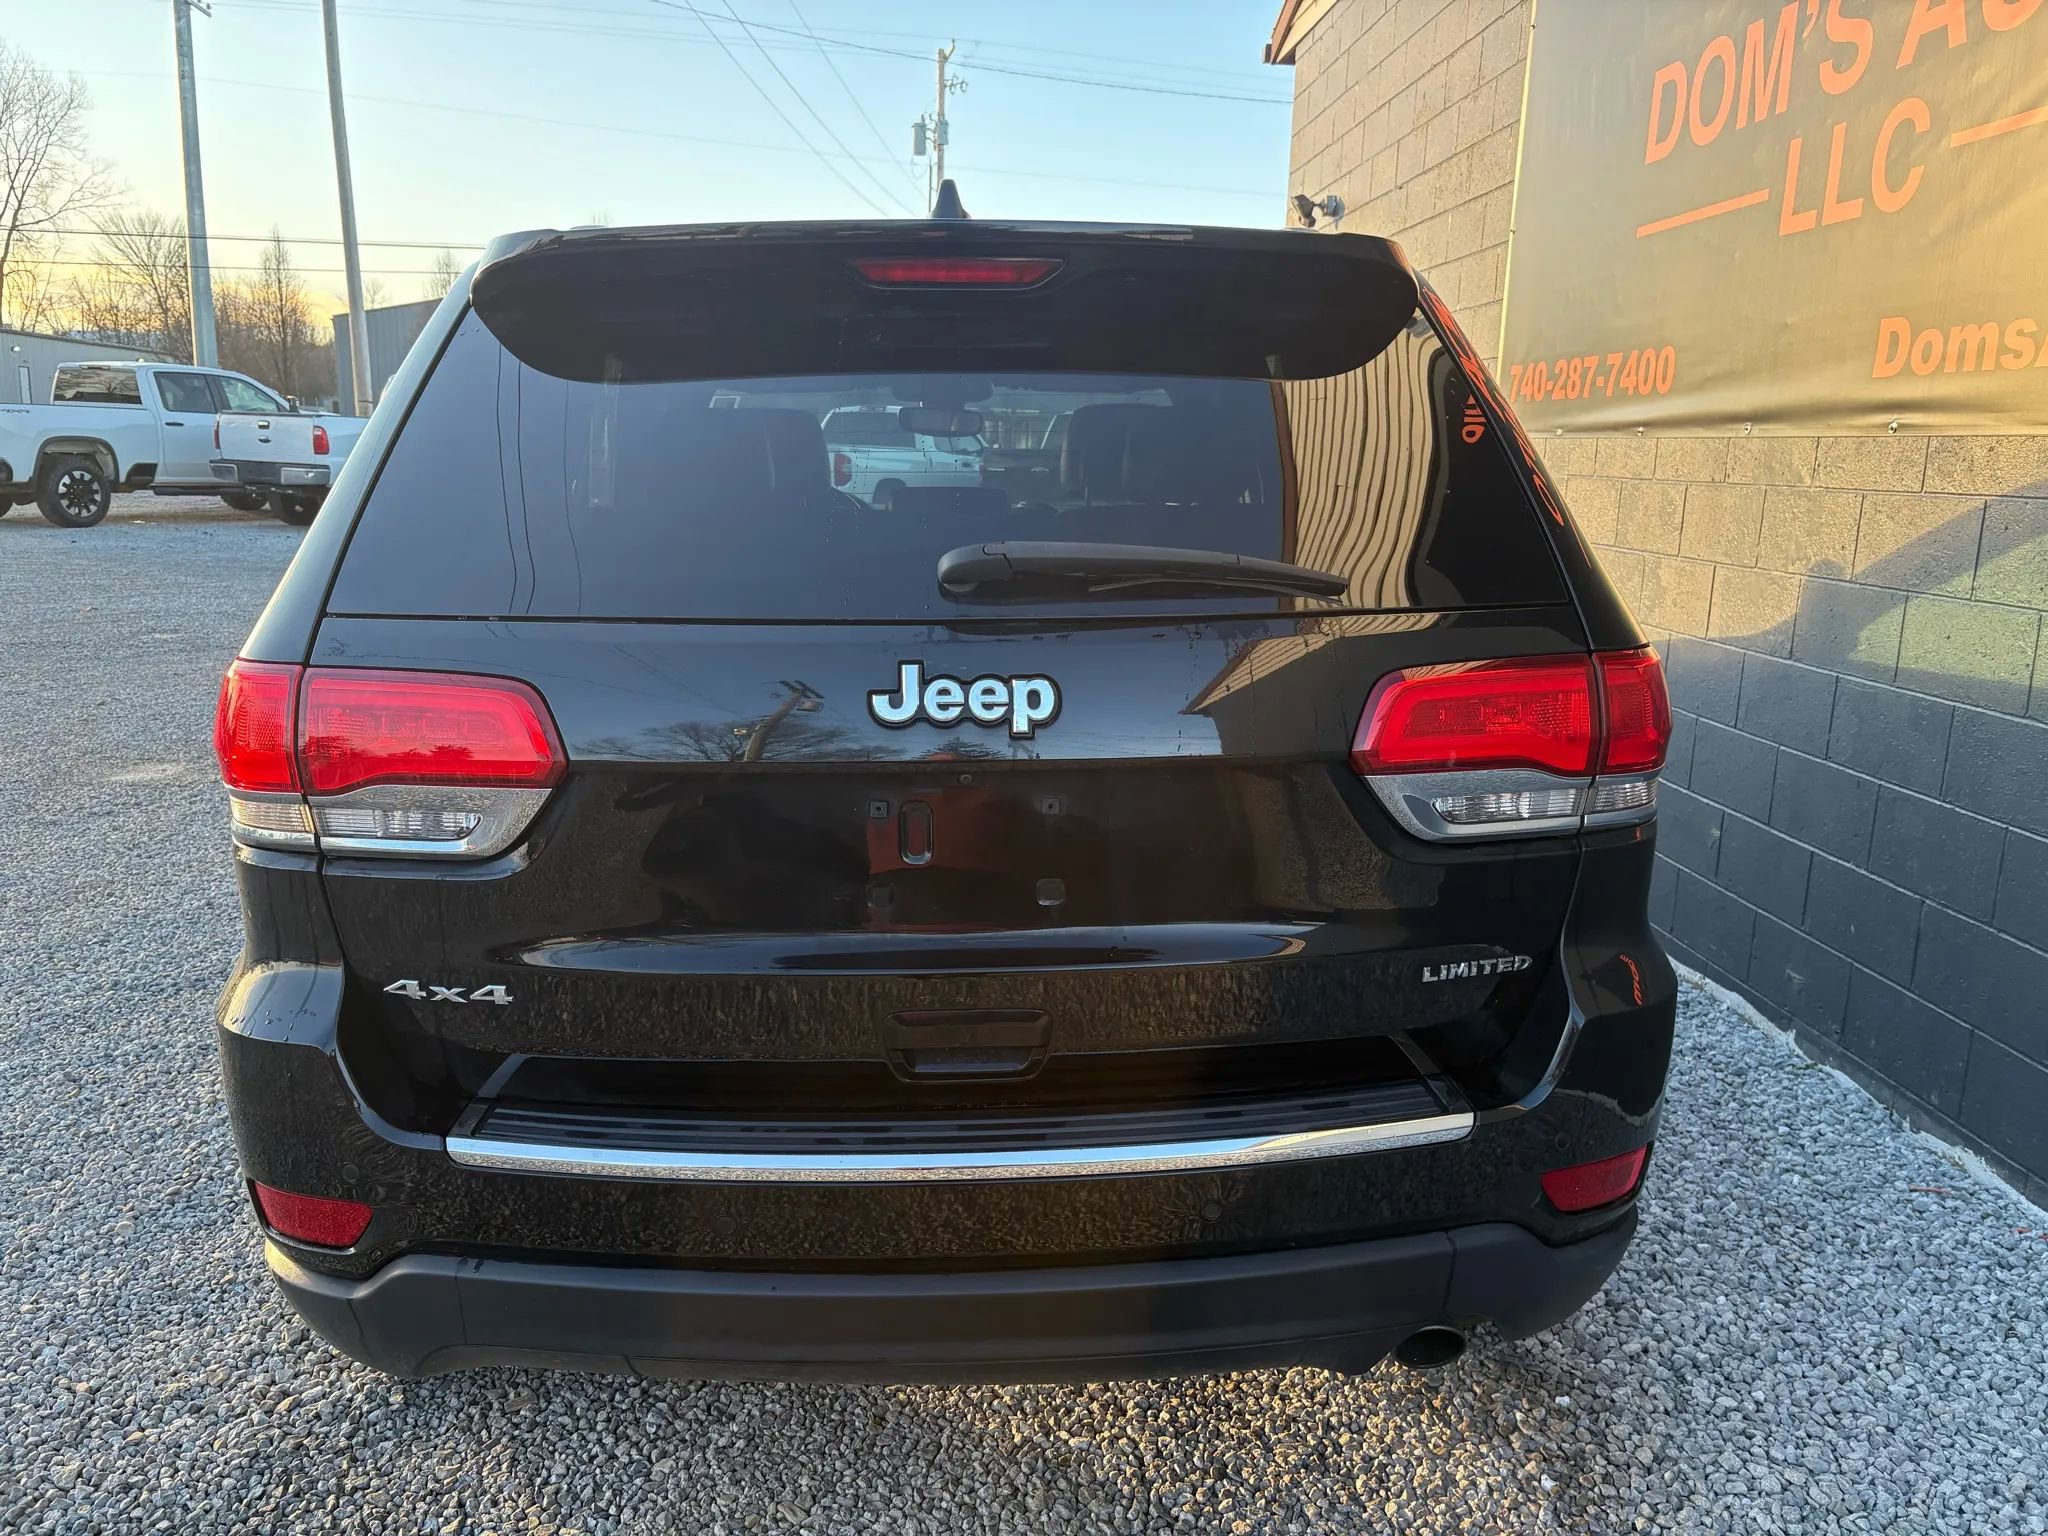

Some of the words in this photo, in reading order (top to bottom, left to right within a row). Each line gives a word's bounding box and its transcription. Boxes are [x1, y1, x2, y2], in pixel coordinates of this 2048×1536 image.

[1645, 0, 1874, 165] DOM'S
[1778, 98, 1931, 236] LLC
[1510, 346, 1676, 403] 740-287-7400
[1872, 317, 2048, 378] Doms
[870, 662, 1059, 736] Jeep
[383, 979, 515, 1005] 4x4
[1422, 955, 1533, 983] LIMITED
